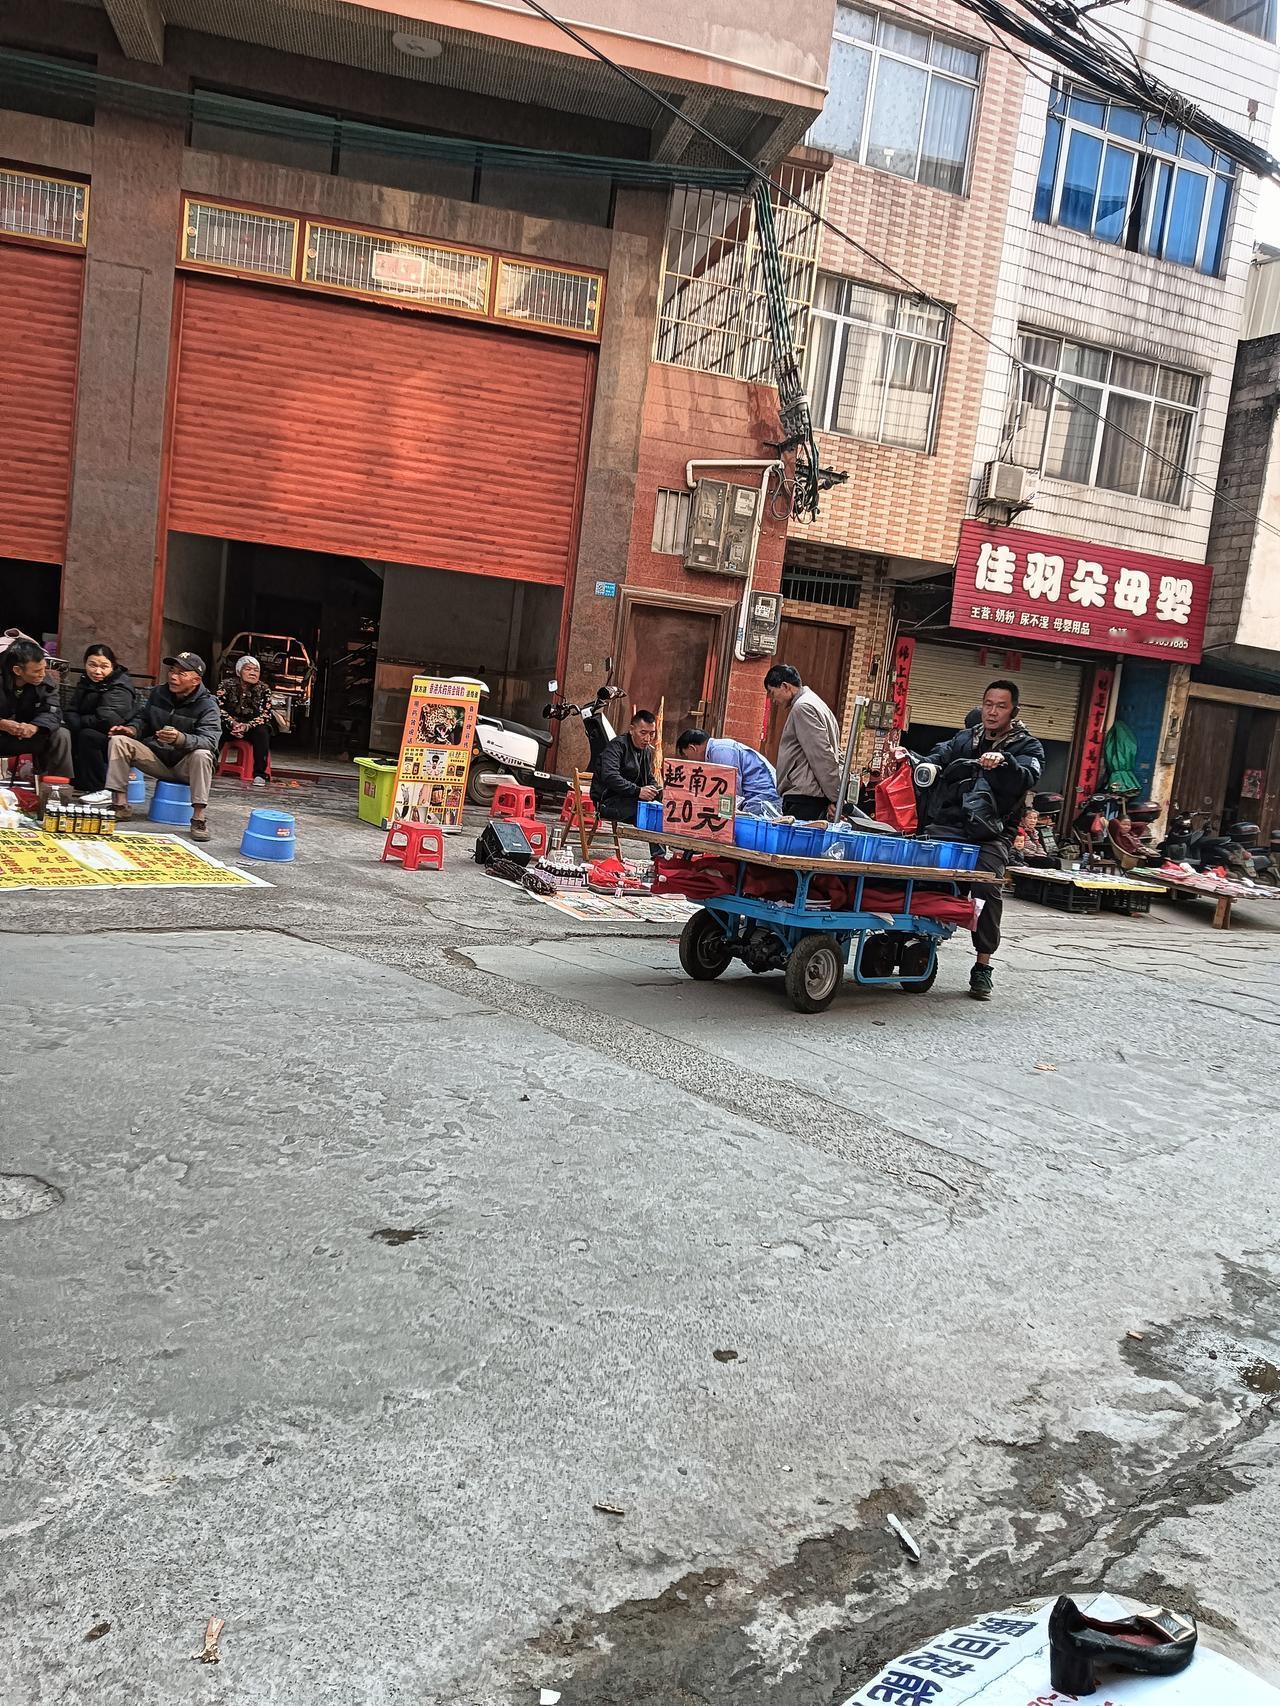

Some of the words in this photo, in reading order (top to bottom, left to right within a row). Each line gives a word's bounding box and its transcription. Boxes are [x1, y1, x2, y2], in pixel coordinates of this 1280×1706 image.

[975, 542, 1194, 625] 佳羽朵母婴
[1020, 612, 1049, 629] 尿不湿
[1053, 617, 1091, 635] 母婴用品
[664, 763, 728, 798] 越南刀
[666, 799, 729, 832] 20元
[852, 1616, 1040, 1706] 瞬间超能
